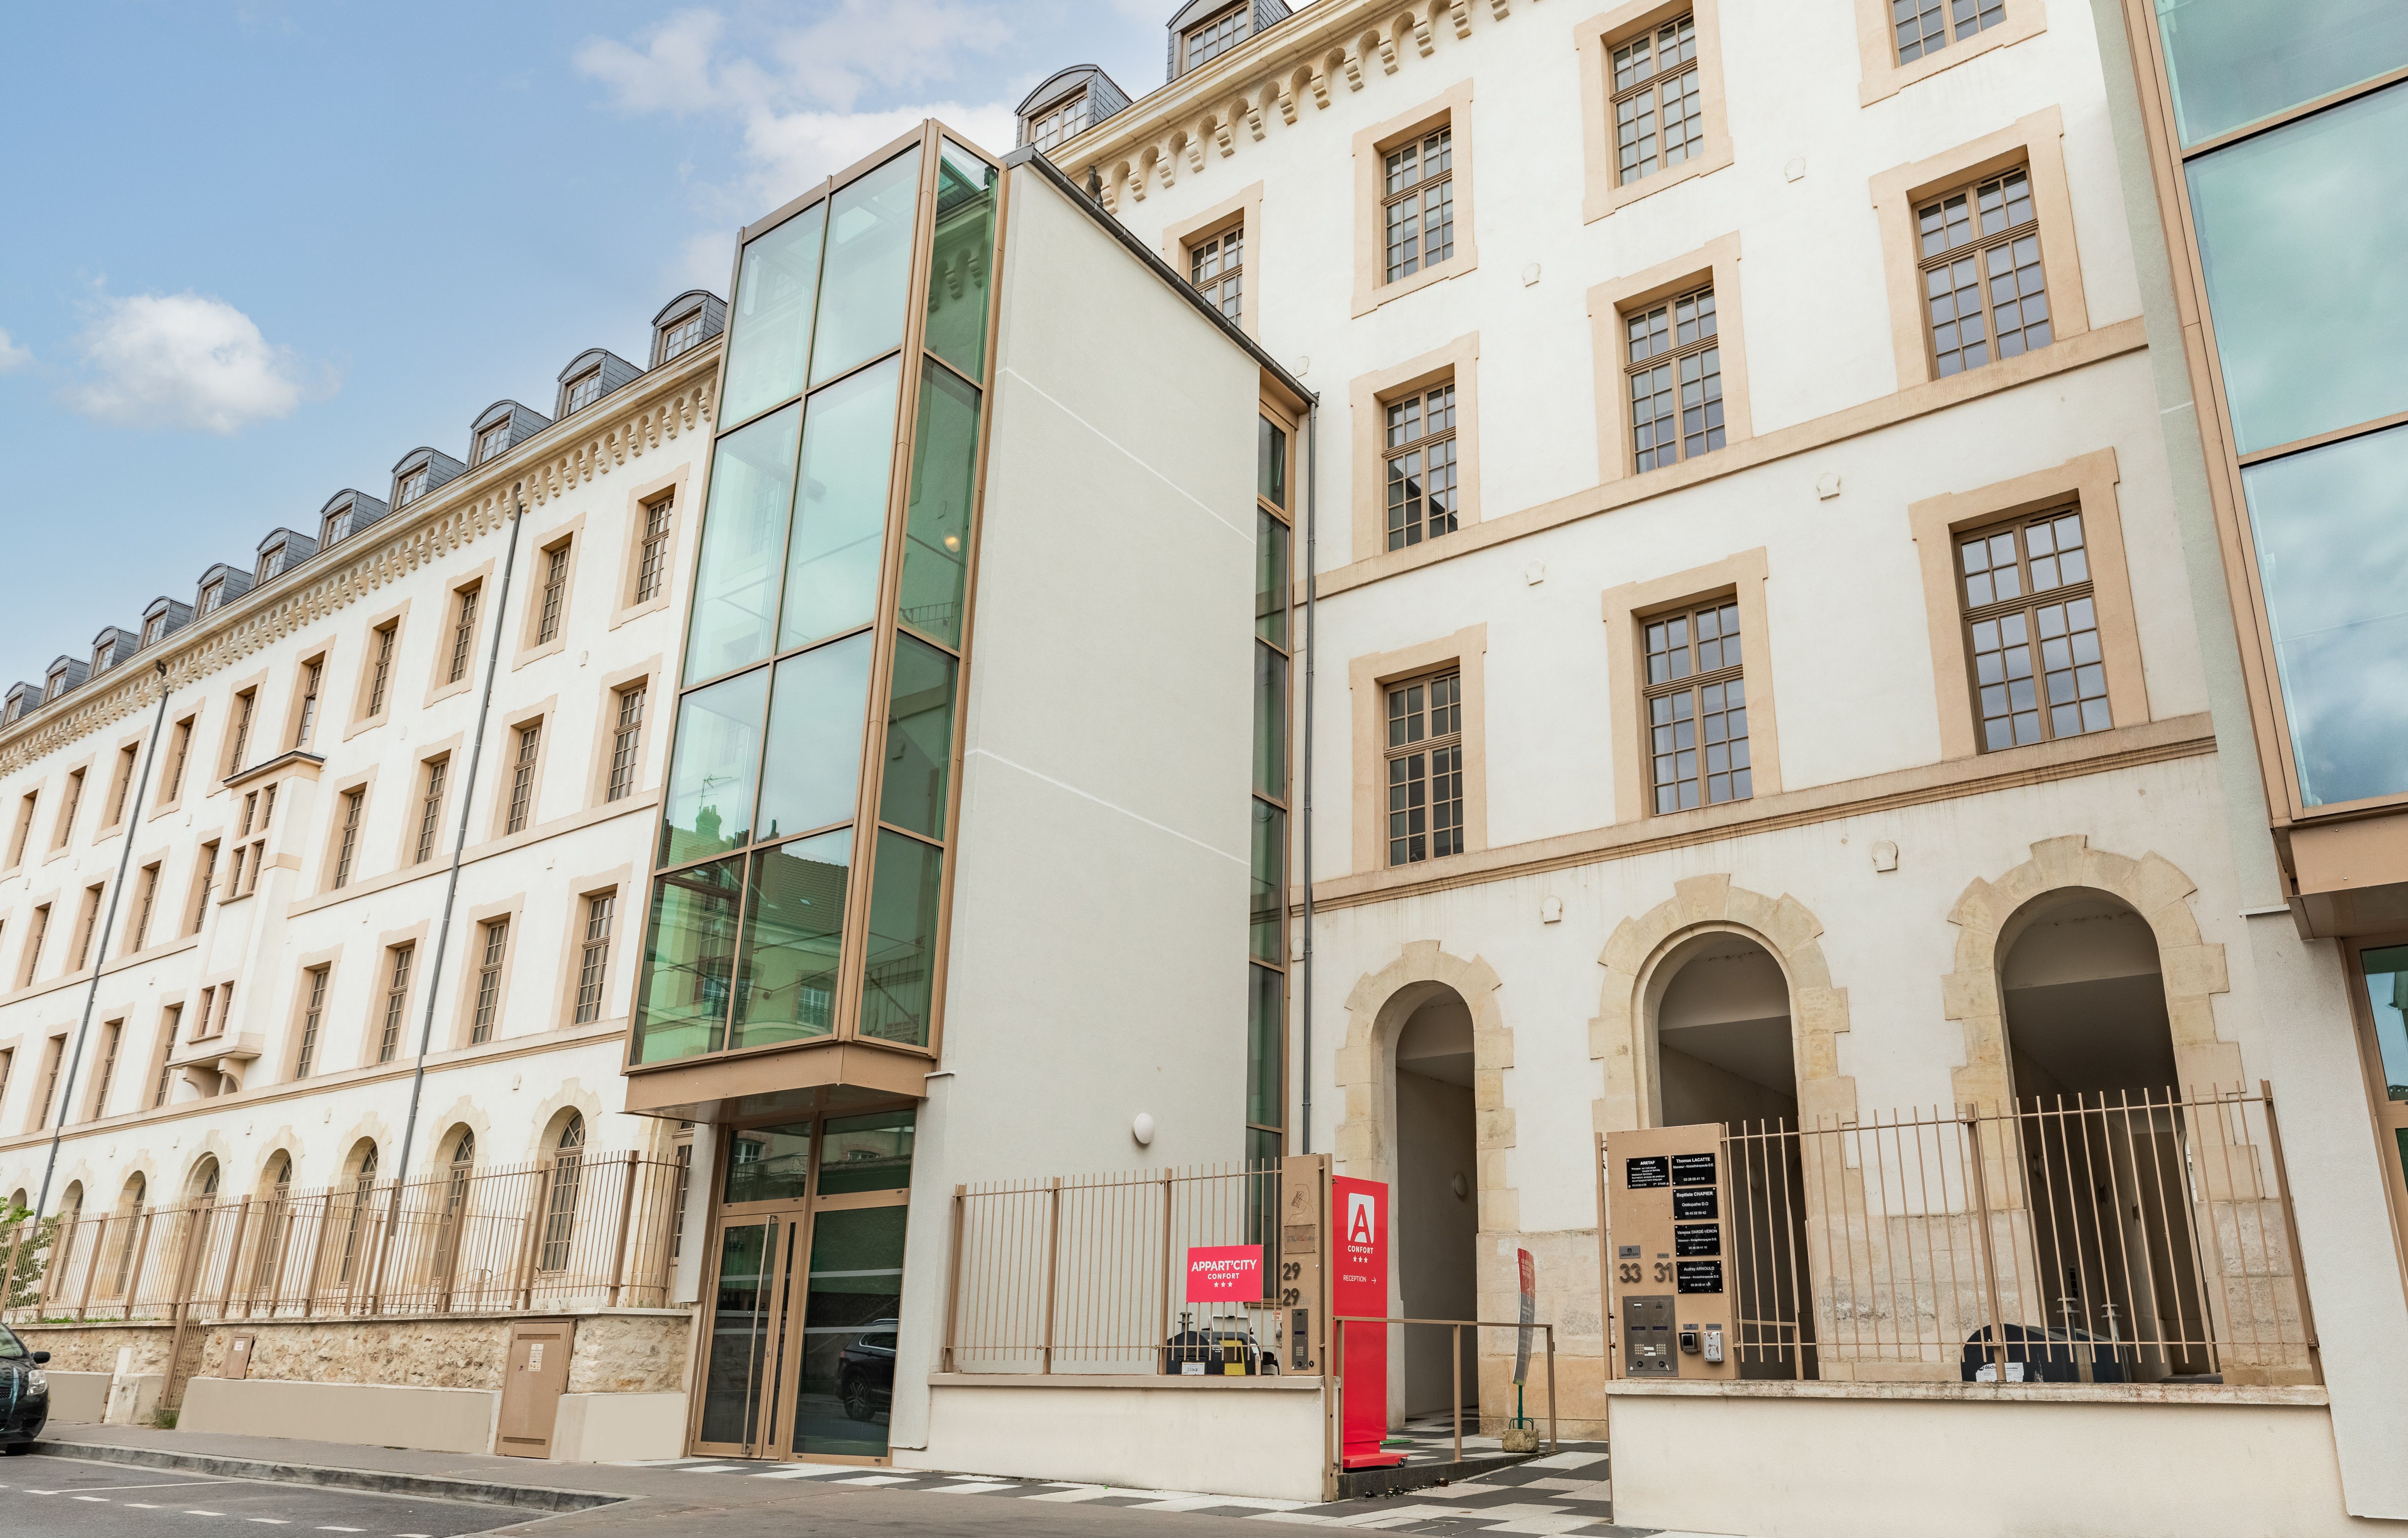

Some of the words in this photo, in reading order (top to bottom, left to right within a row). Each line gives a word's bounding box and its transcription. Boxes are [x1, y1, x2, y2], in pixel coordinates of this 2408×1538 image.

[1348, 1245, 1373, 1254] CONFORT
[1191, 1259, 1257, 1272] APPART'CITY
[1283, 1262, 1300, 1280] 29
[1620, 1263, 1641, 1283] 33
[1654, 1262, 1673, 1282] 31
[1283, 1288, 1300, 1306] 29
